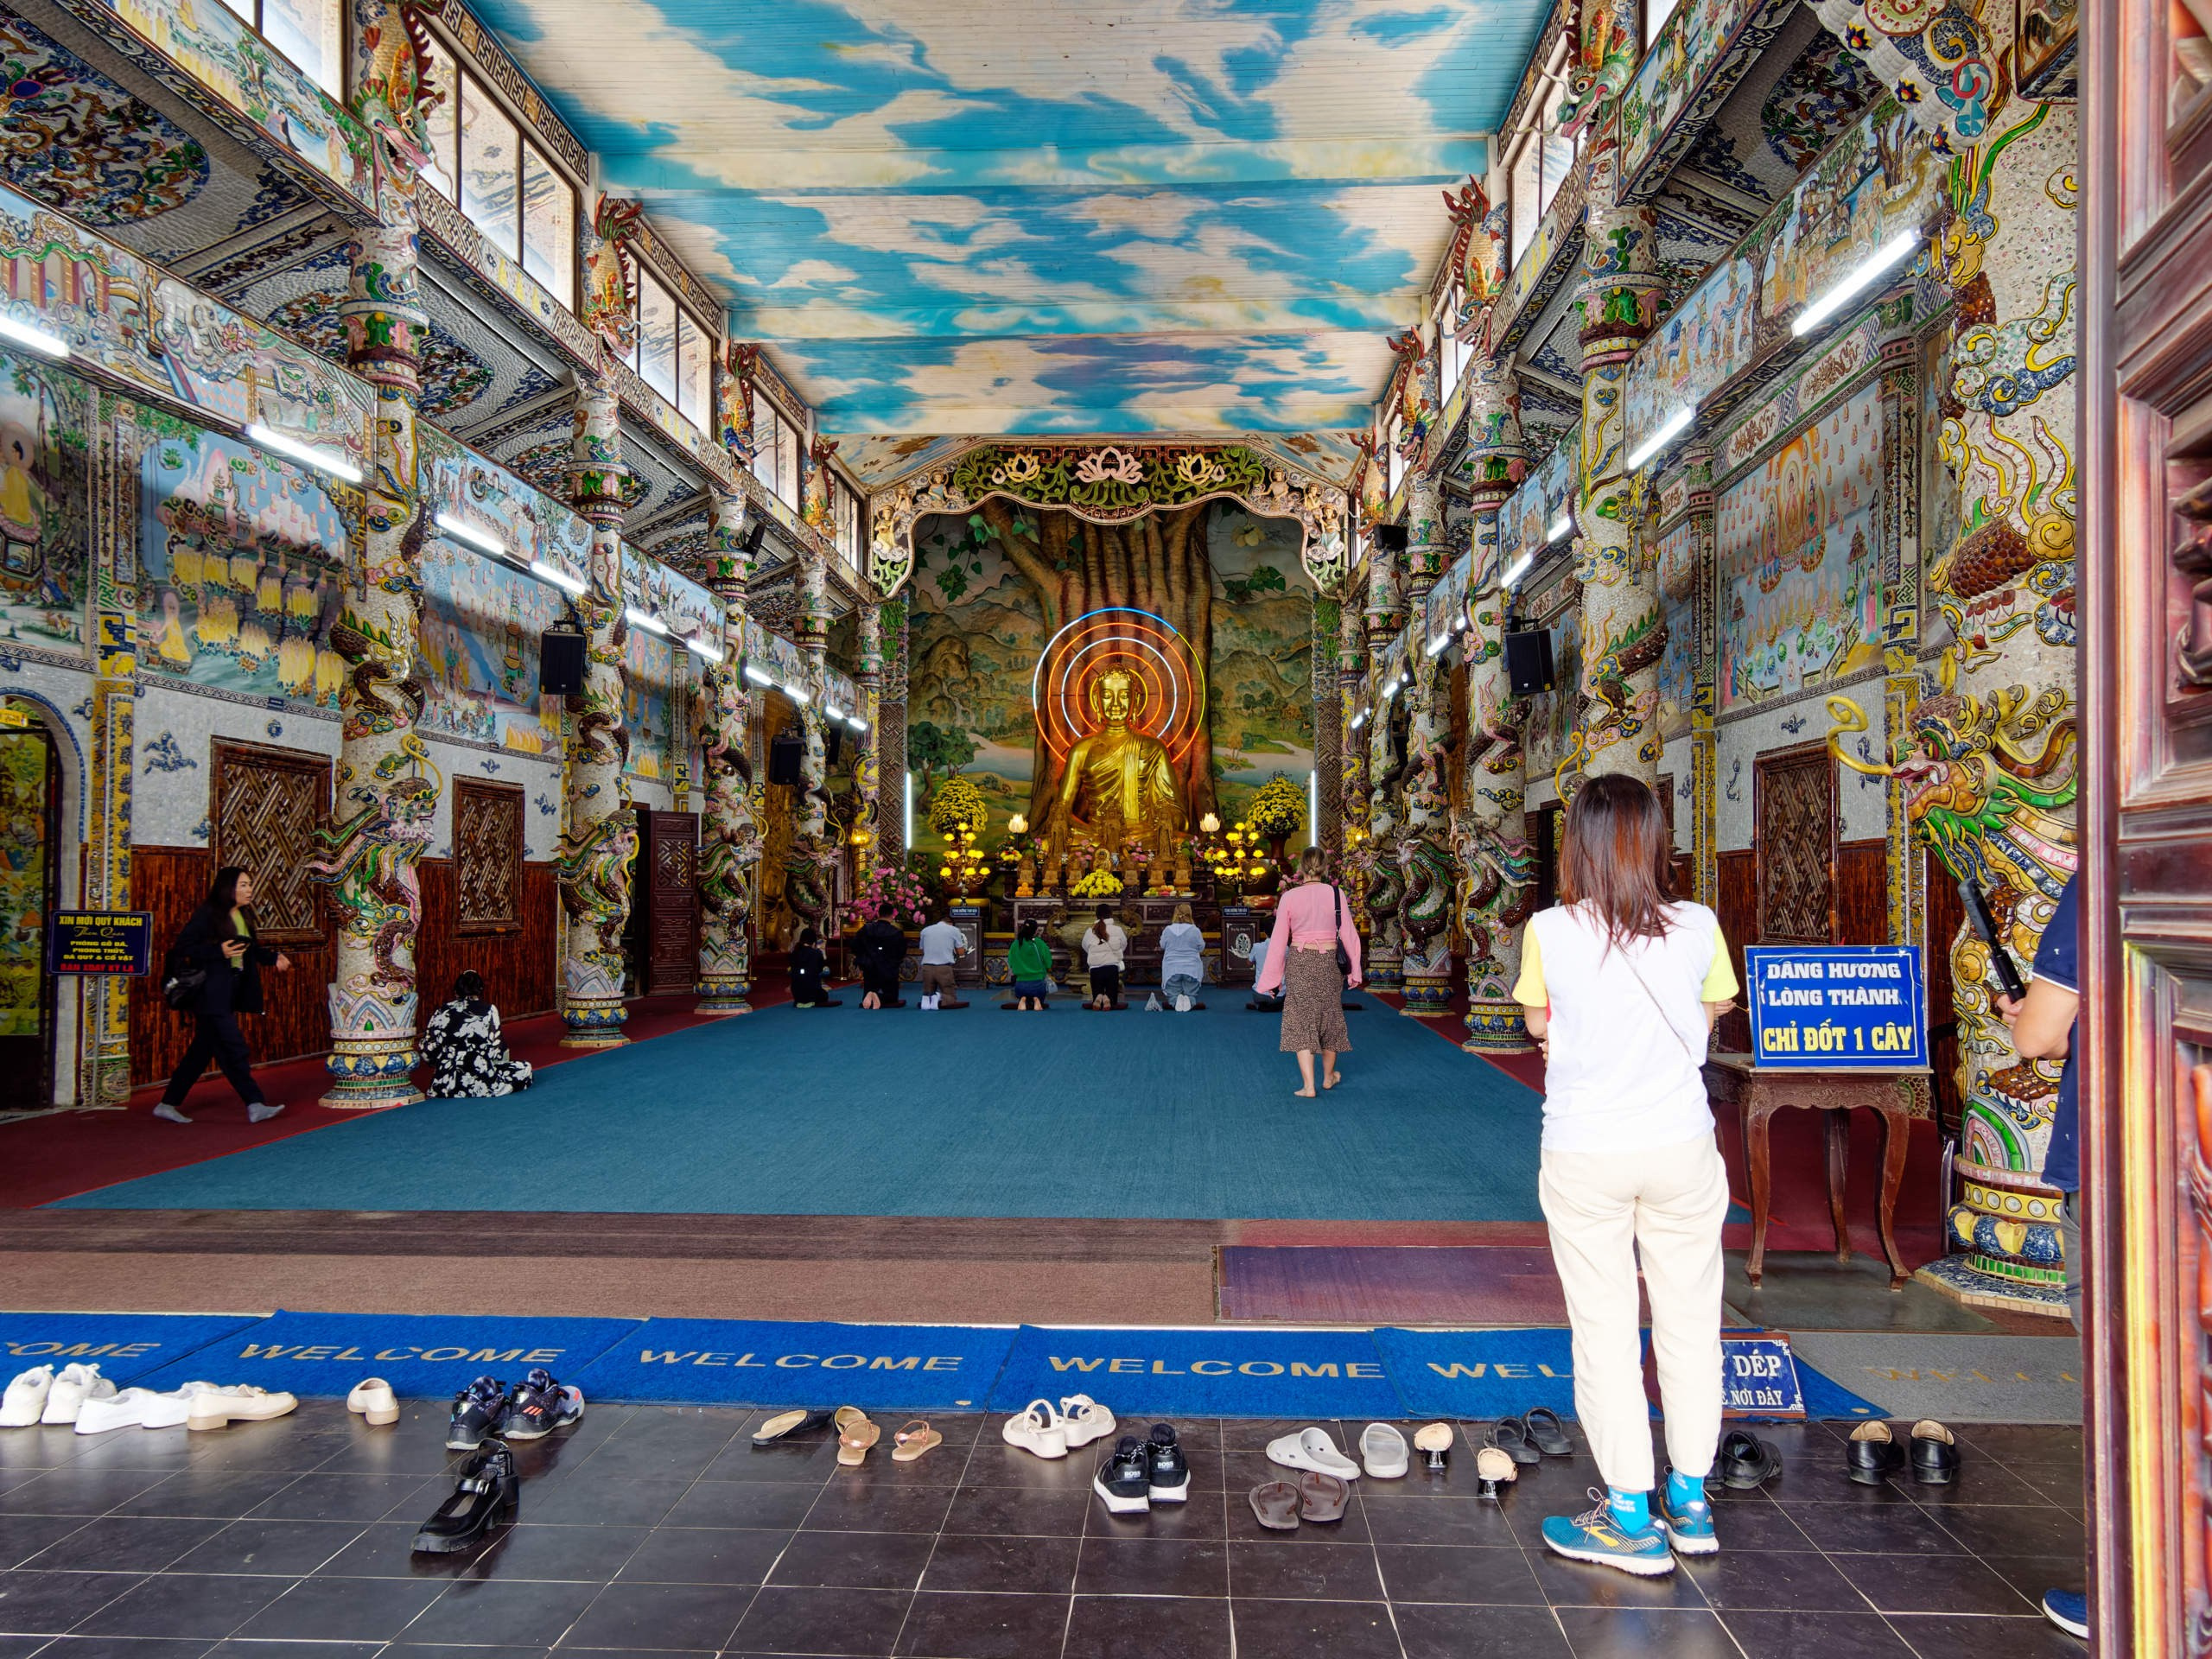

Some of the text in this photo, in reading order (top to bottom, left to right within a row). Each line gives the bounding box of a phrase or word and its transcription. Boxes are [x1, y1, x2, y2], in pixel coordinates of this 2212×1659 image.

[59, 916, 74, 925] XIN
[114, 916, 143, 926] KHÁCH
[1767, 961, 1901, 979] DÂNG HƯƠNG
[1769, 986, 1899, 1007] LÒNG THÀNH
[1764, 1018, 1912, 1052] CHỈ ĐỐT 1 CÂY
[239, 1344, 565, 1363] WELCOME
[640, 1350, 963, 1371] WELCOME
[1732, 1349, 1781, 1376] DÉP
[1048, 1357, 1385, 1378] WELCOME
[1427, 1363, 1574, 1378] WEL
[1730, 1388, 1755, 1406] NƠI
[1756, 1386, 1783, 1406] ĐÂY
